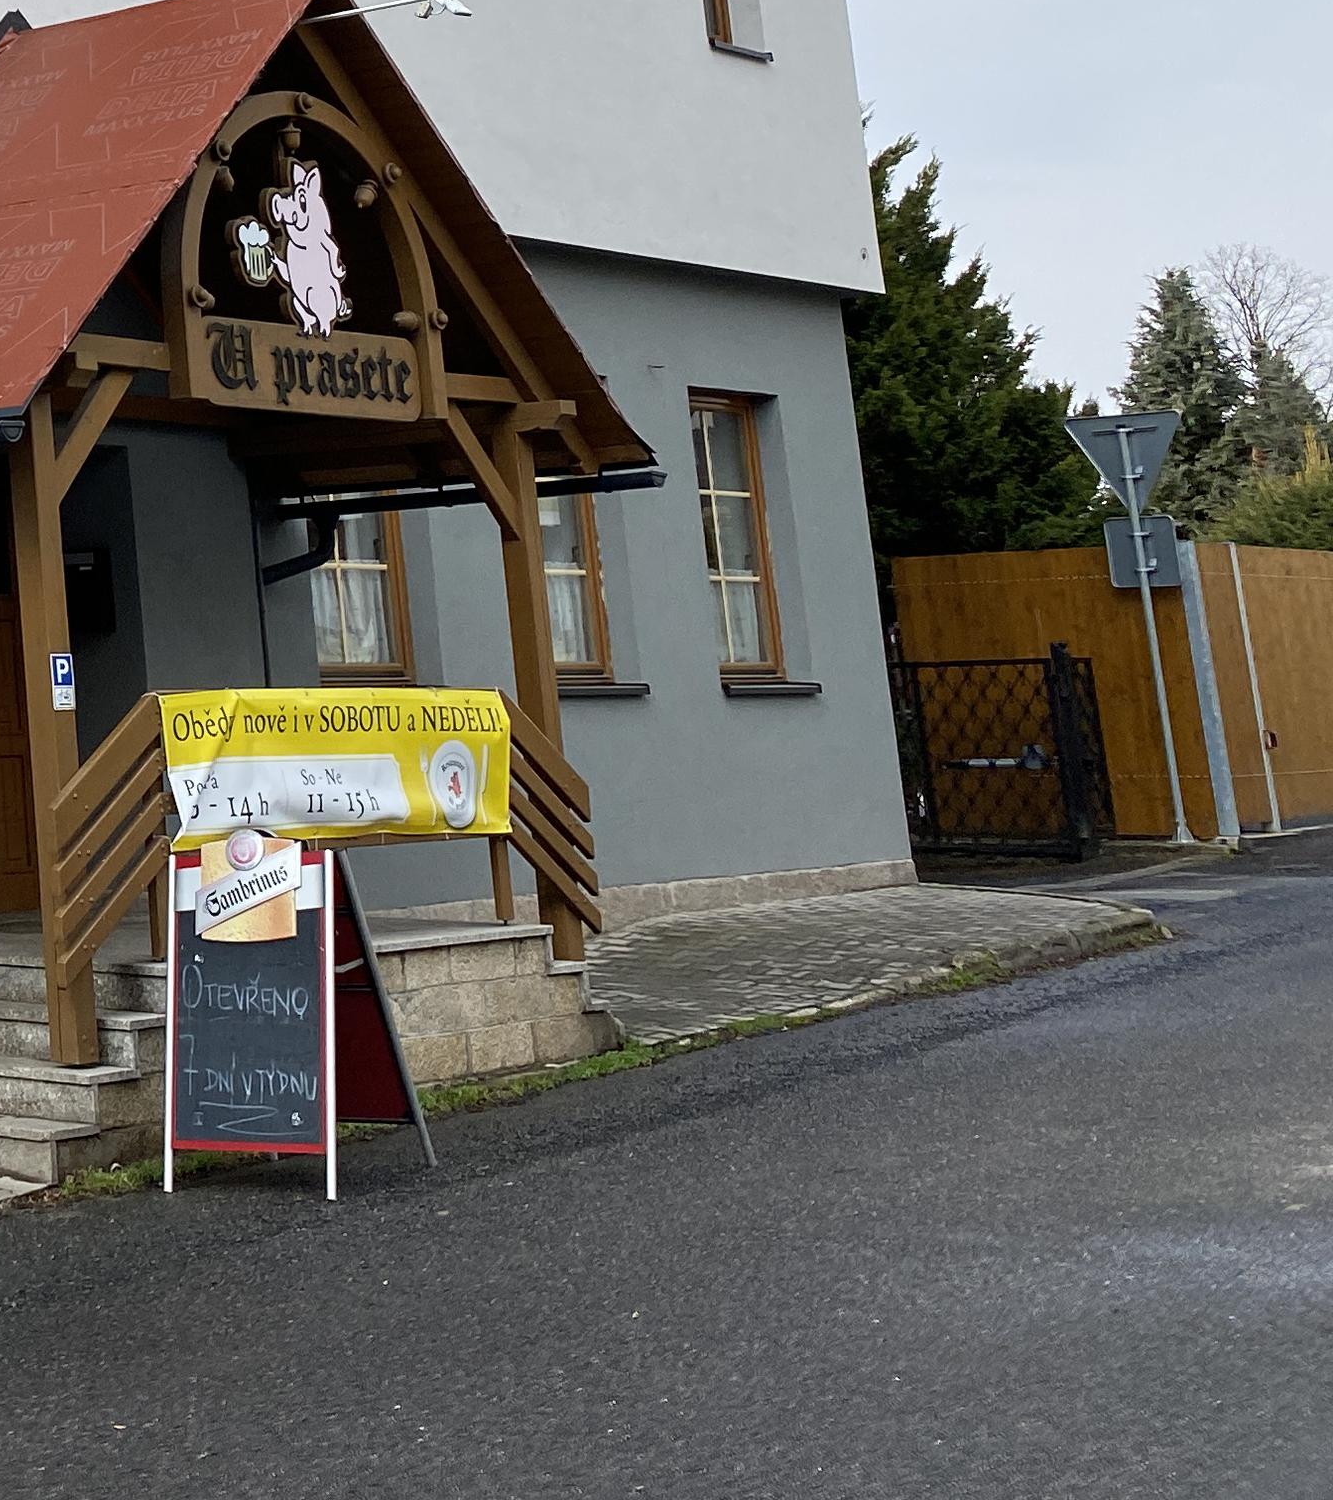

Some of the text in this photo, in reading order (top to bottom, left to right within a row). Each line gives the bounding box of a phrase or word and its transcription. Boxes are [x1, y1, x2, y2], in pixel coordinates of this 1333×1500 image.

[96, 79, 217, 120] DELTA
[206, 322, 414, 406] U prasete
[173, 699, 504, 742] Obědy nově i v SOBOTU a NEDĚLI!
[307, 793, 324, 814] 11
[205, 864, 289, 918] Gambrinus
[181, 964, 310, 1020] OTEVŘENO
[179, 1033, 199, 1096] 7
